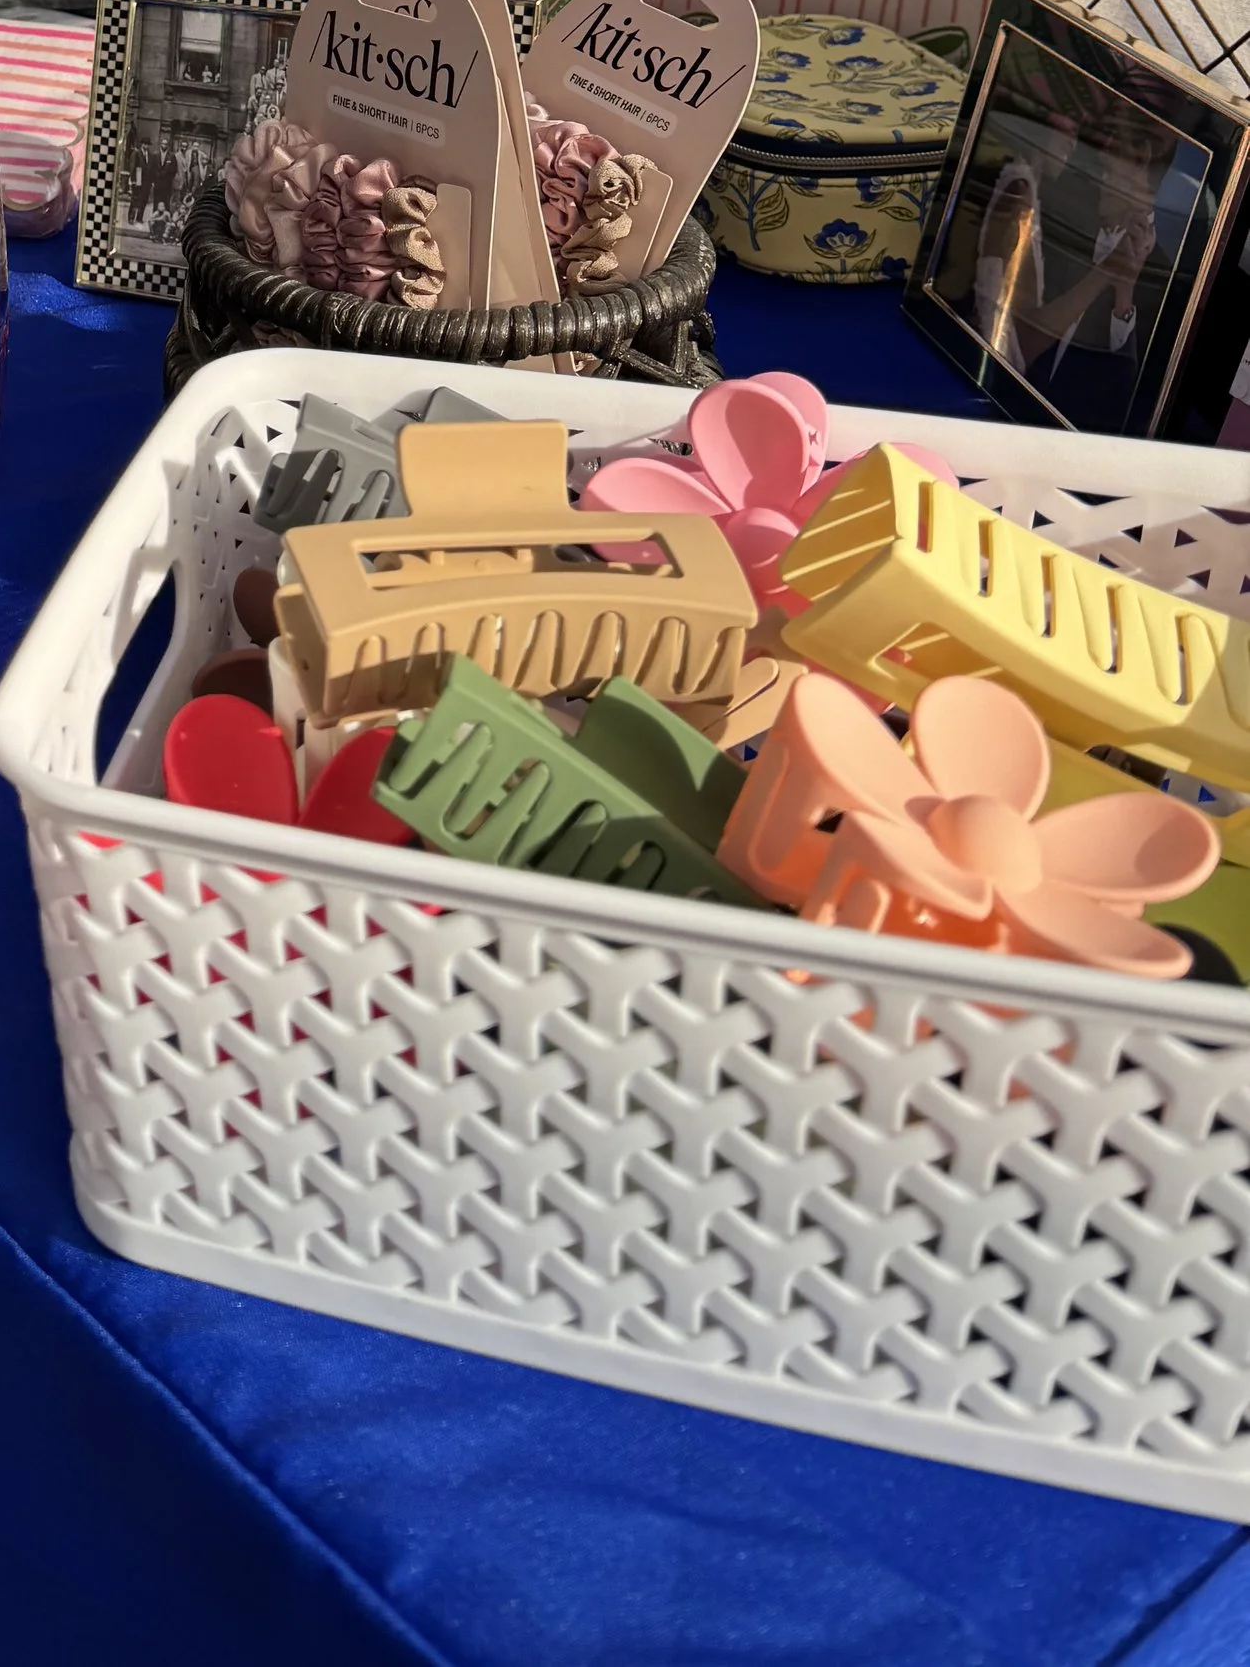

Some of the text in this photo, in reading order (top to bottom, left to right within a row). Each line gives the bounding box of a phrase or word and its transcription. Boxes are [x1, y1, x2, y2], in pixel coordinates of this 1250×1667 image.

[332, 94, 352, 109] FINE
[358, 103, 388, 122] SHORT
[387, 112, 409, 129] HAIR
[415, 121, 440, 140] 6PCS
[569, 72, 588, 90] FINE
[592, 85, 623, 106] SHORT
[619, 99, 642, 117] HAIR
[645, 112, 671, 132] 6PCS
